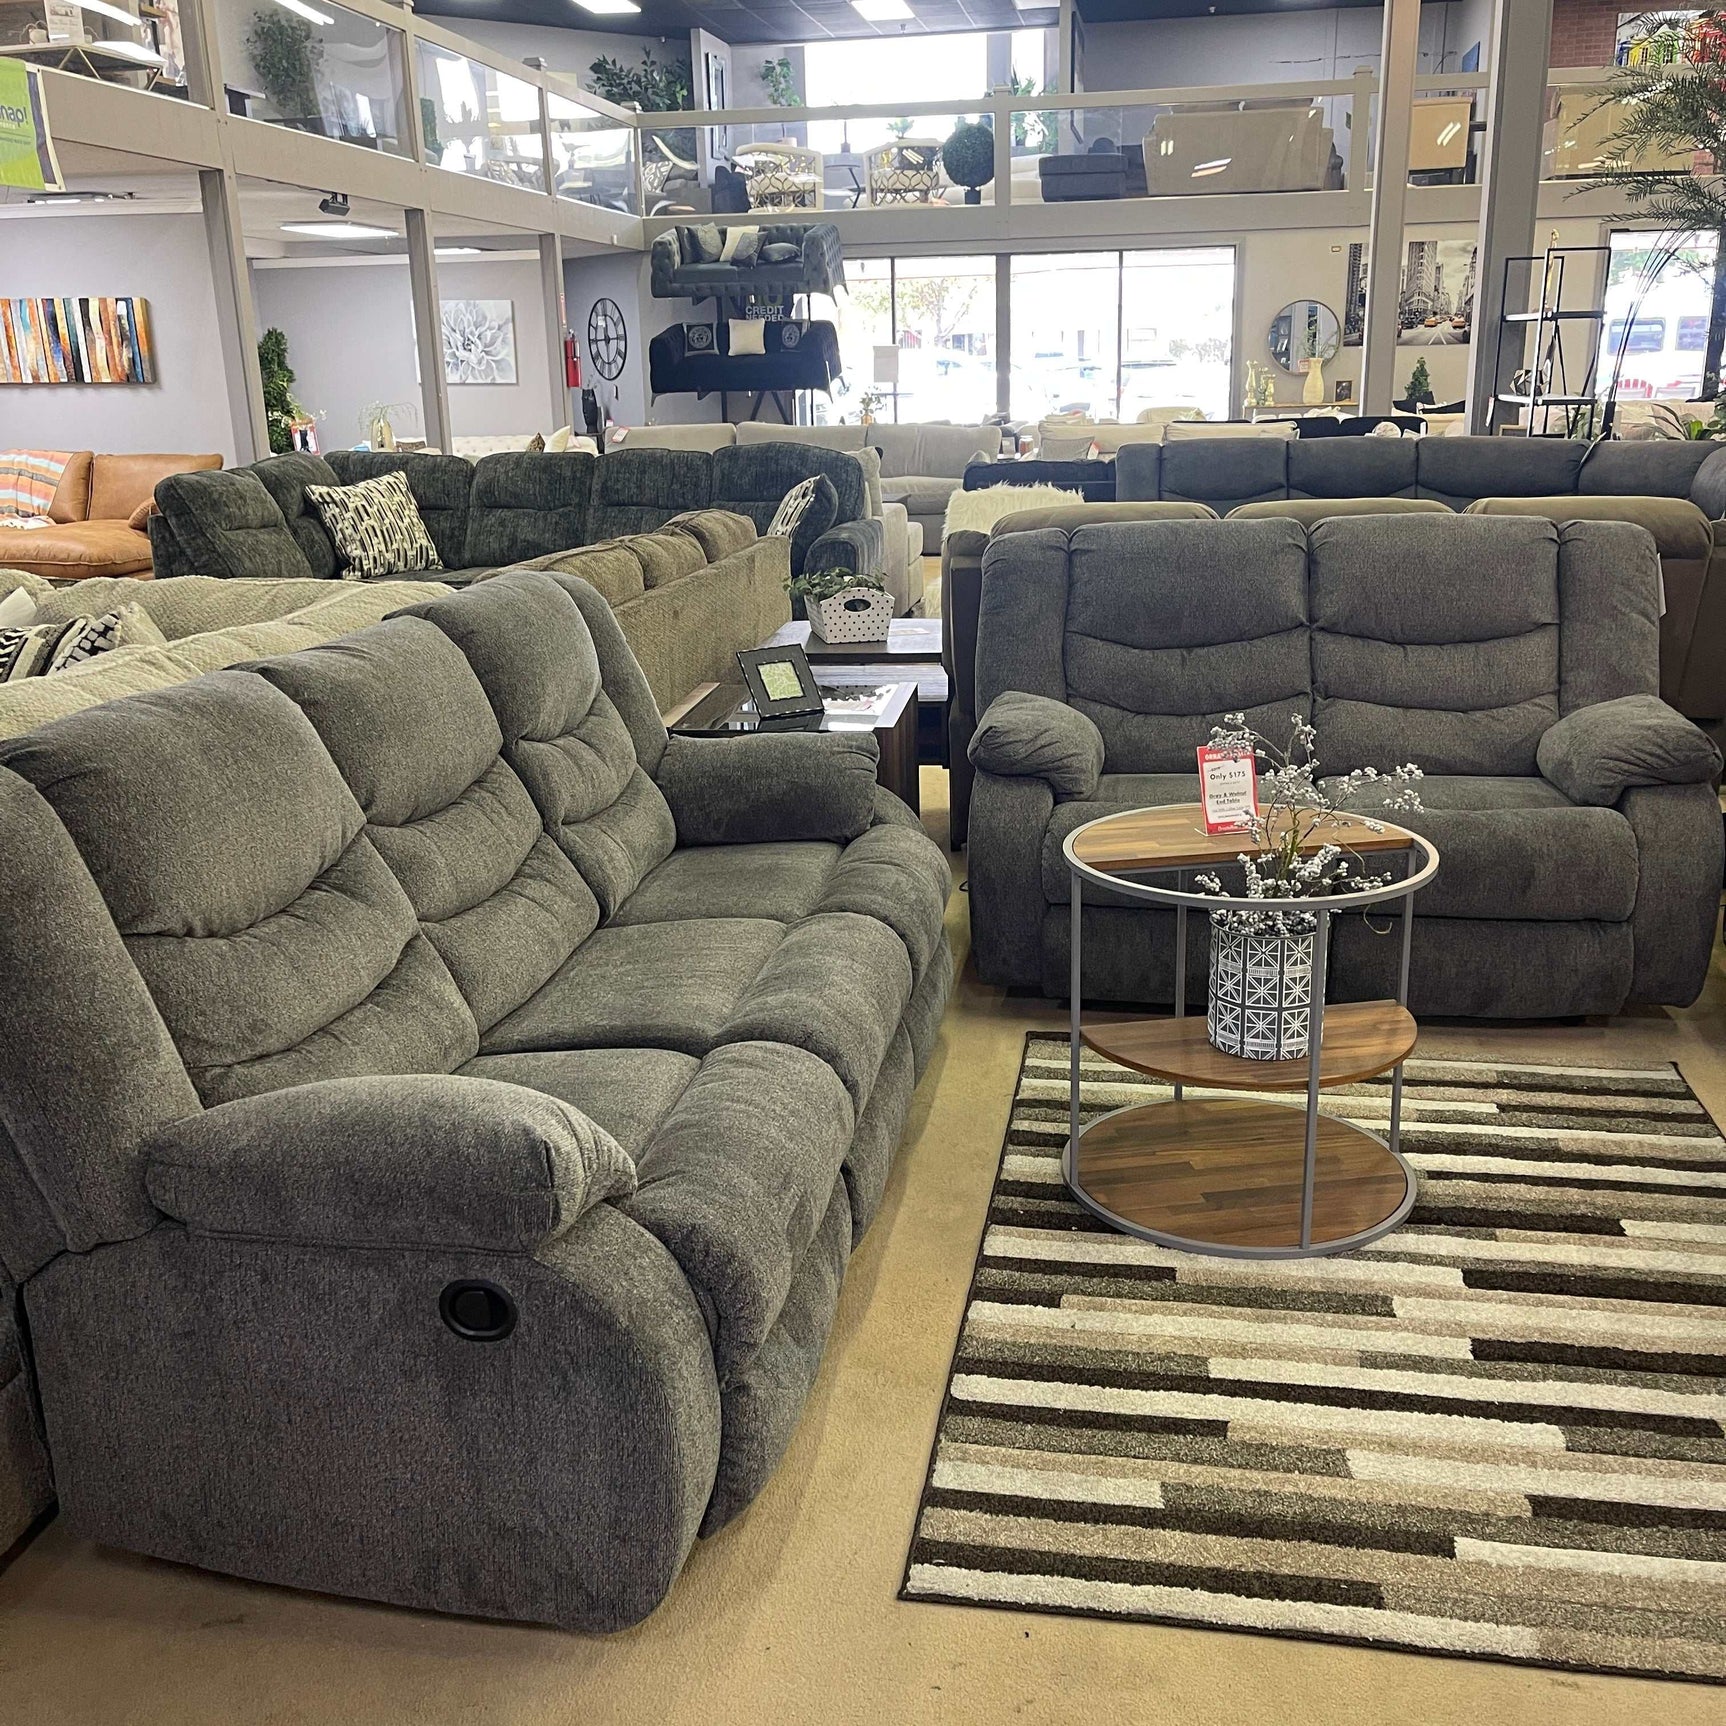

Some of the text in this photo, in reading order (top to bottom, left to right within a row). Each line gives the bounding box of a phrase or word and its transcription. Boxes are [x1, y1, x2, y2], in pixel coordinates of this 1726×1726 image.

[0, 105, 28, 128] nap!
[745, 305, 784, 315] CREDIT
[1210, 770, 1246, 780] Only $175
